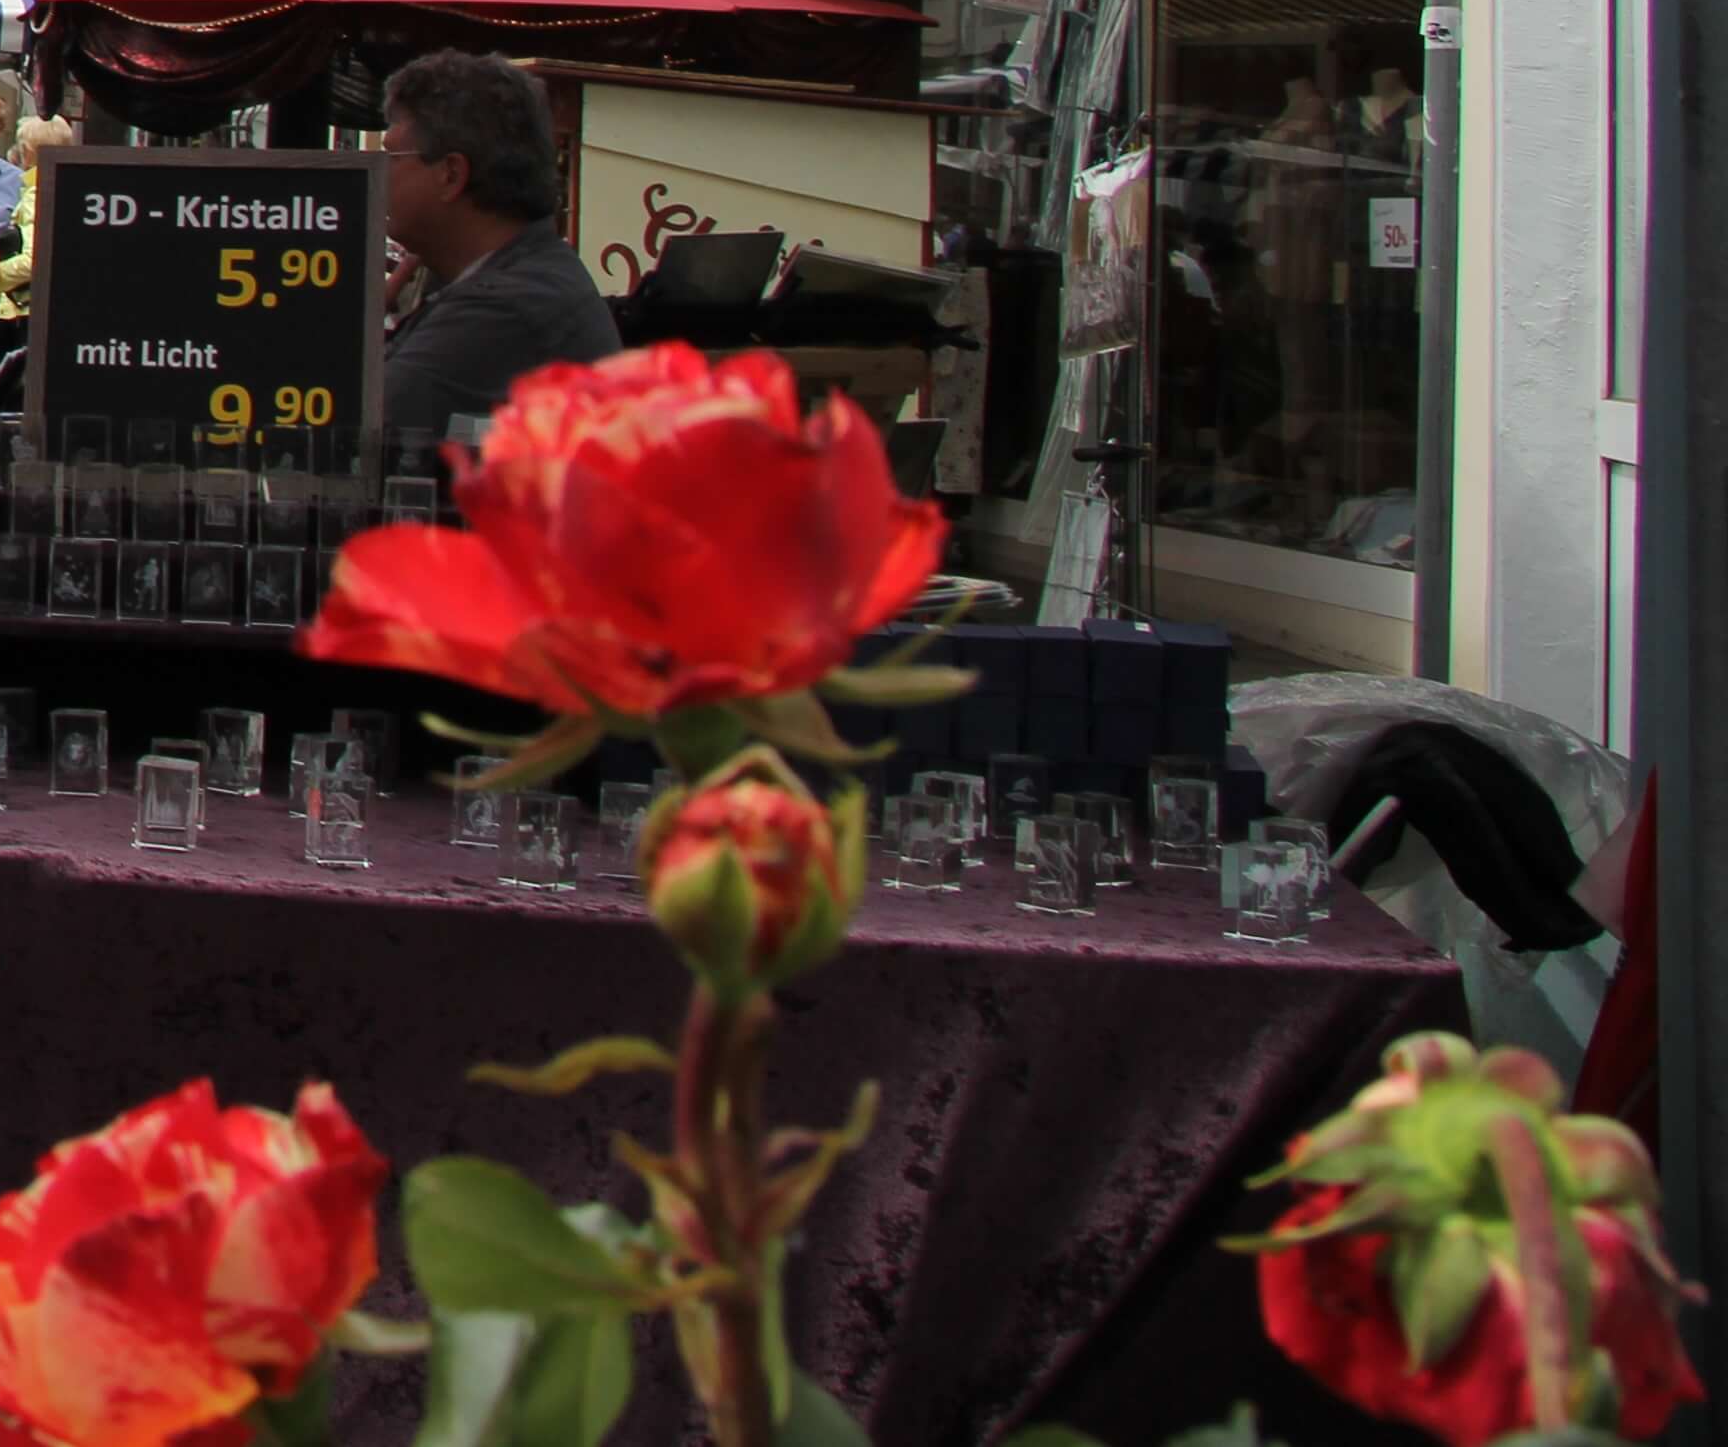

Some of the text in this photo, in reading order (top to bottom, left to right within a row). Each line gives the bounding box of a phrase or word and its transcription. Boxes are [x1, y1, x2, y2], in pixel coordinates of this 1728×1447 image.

[82, 193, 138, 226] 3D
[176, 195, 340, 231] Kristalle
[216, 248, 339, 308] 5.90
[76, 338, 219, 369] mit Licht
